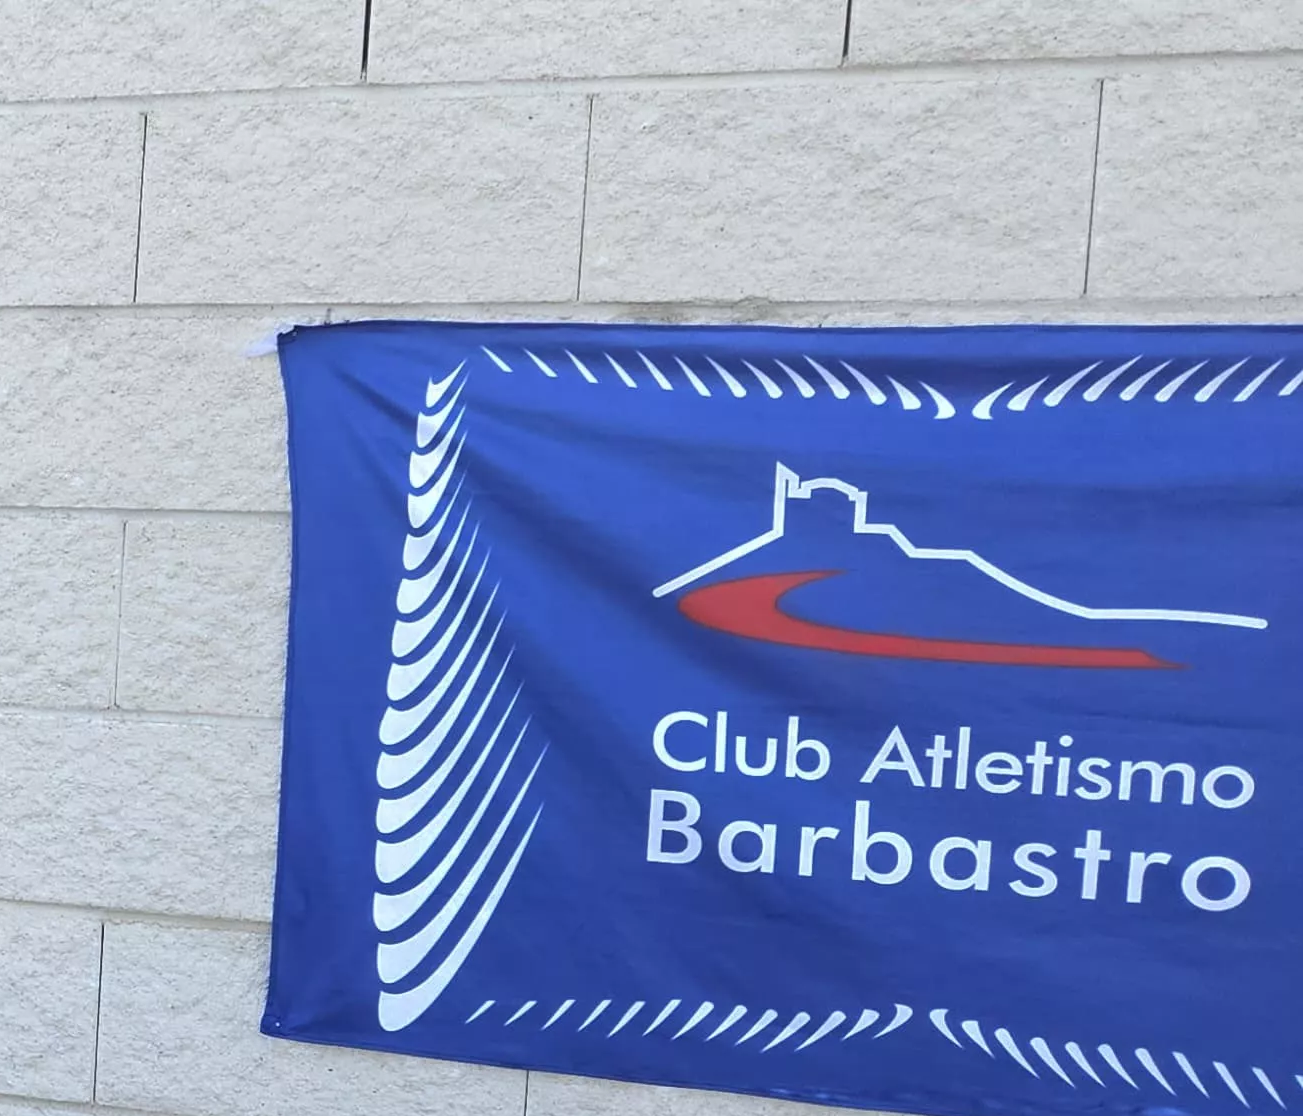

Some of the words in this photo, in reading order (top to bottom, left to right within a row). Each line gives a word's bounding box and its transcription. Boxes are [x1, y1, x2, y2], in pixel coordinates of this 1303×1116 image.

[652, 710, 831, 782] Club
[859, 725, 1256, 810] Atletismo
[646, 788, 1252, 912] Barbastro
